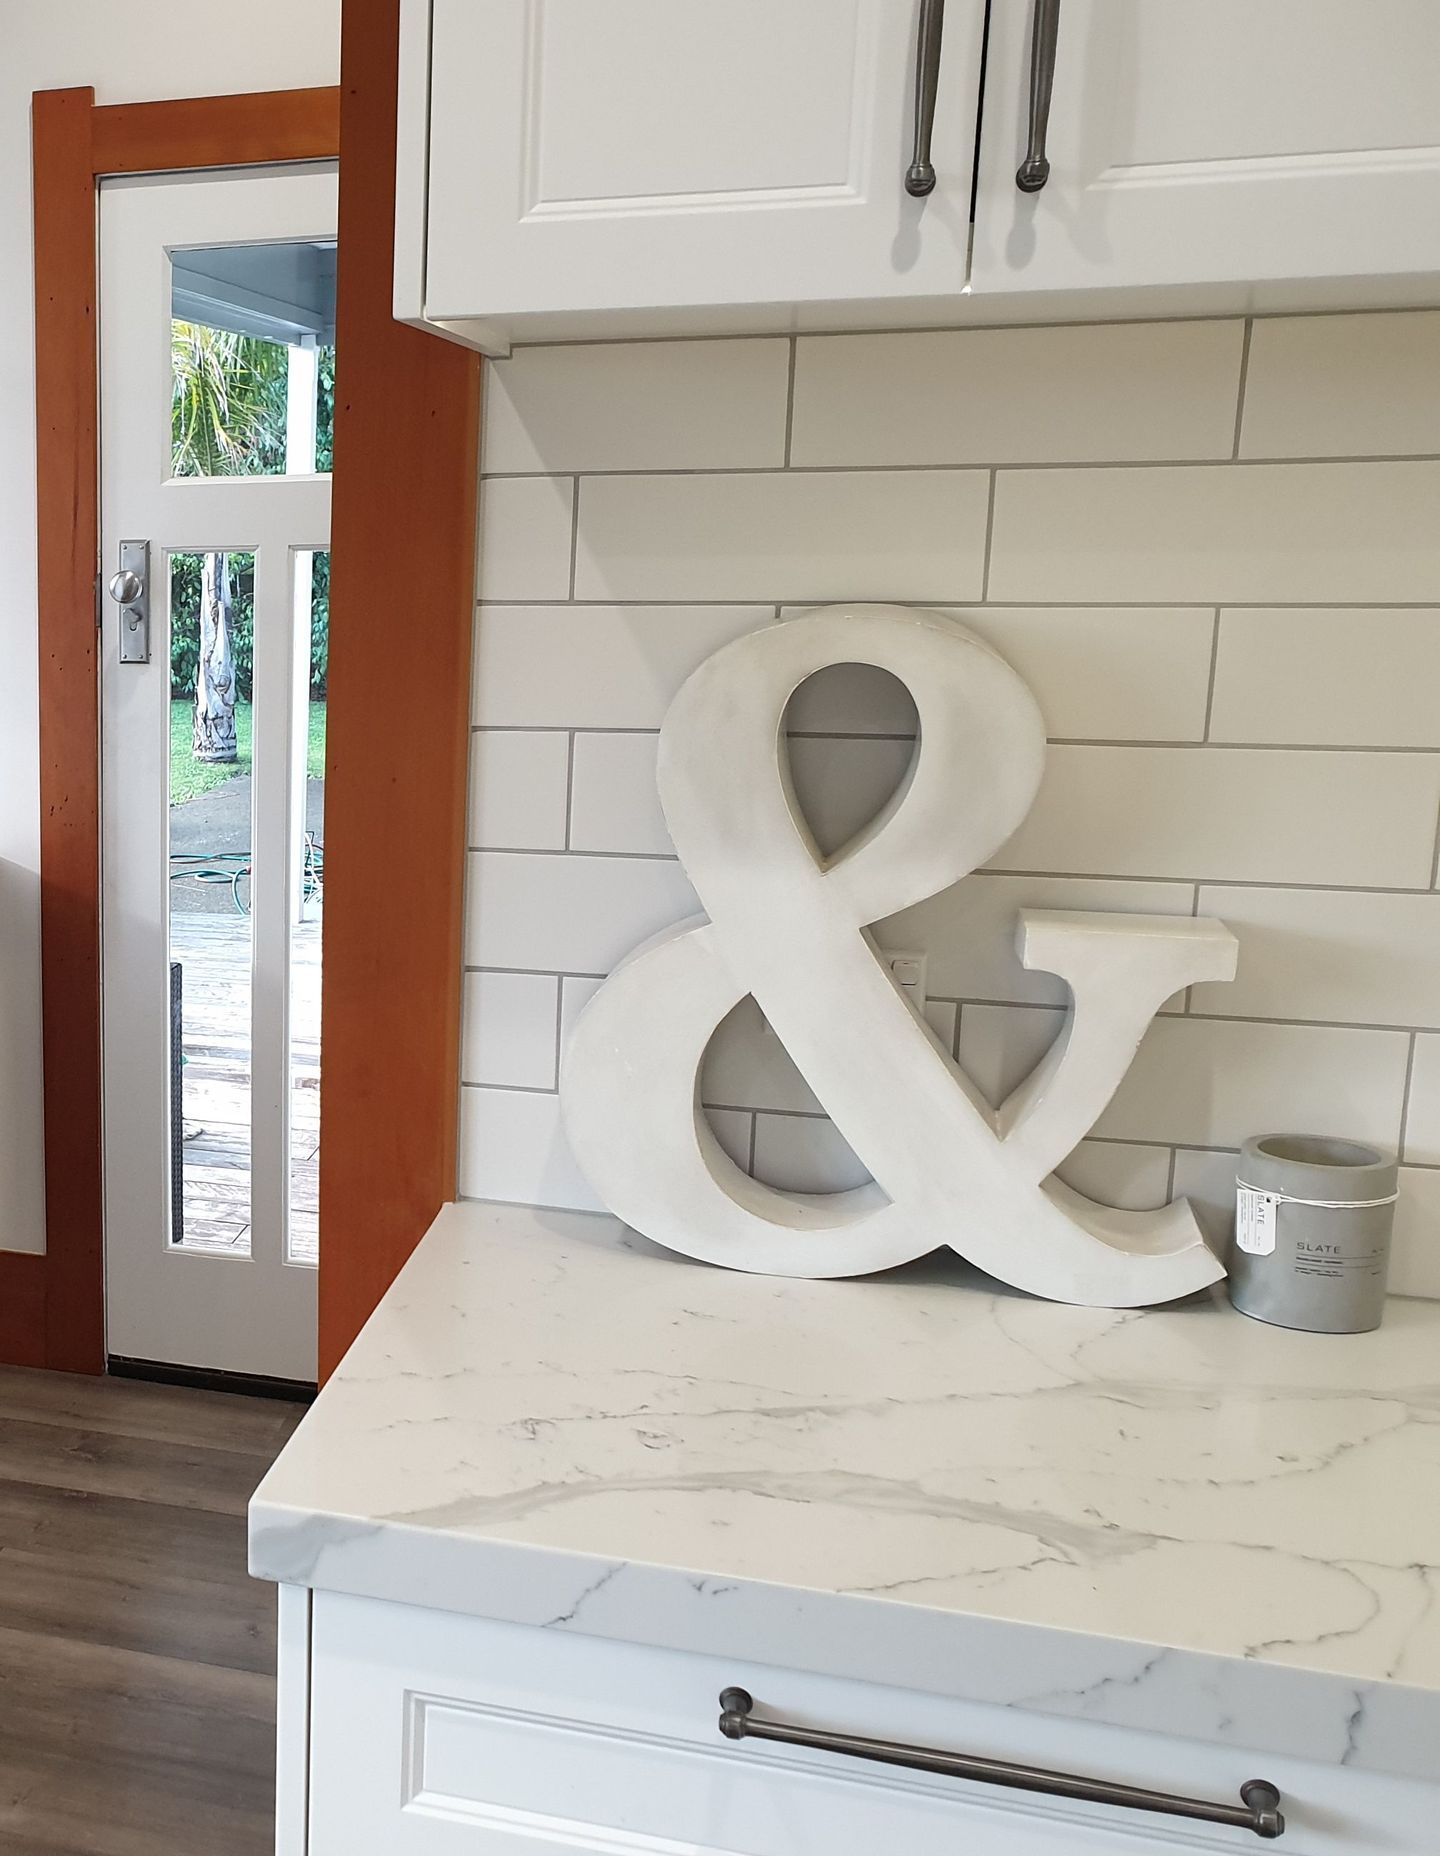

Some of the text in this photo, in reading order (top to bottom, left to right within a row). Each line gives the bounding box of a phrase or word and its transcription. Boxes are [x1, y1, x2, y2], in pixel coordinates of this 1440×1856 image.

[563, 603, 1238, 1309] &
[1257, 1194, 1265, 1225] SLATE
[1296, 1241, 1342, 1254] SLATE
